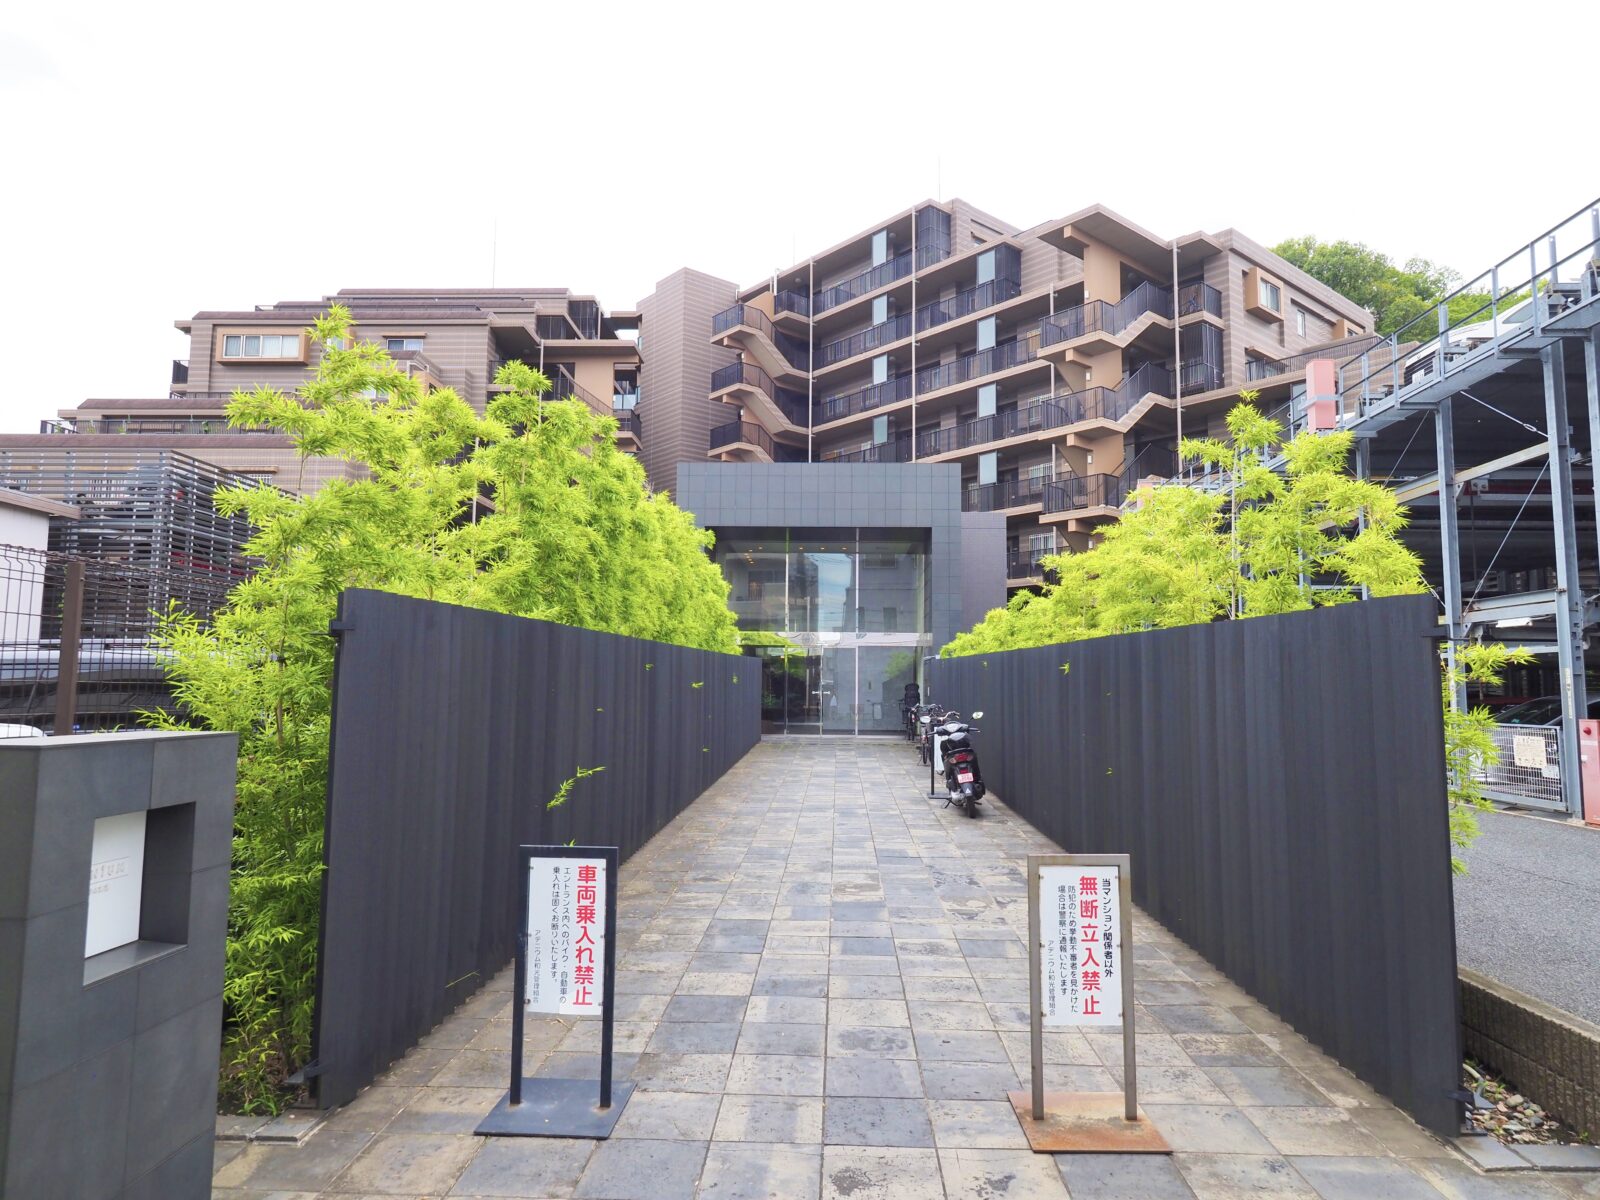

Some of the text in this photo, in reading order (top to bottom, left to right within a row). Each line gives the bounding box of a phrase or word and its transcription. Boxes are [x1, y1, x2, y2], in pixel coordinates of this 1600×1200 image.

[573, 865, 597, 1006] 車両乗入れ禁止
[1057, 885, 1067, 995] 場合は警察に通報いたします
[1067, 885, 1078, 1013] 防犯のため挙動不審者を見かけた
[1079, 875, 1101, 1015] 無断立入禁止
[1102, 878, 1113, 978] 当マンション関係者以外
